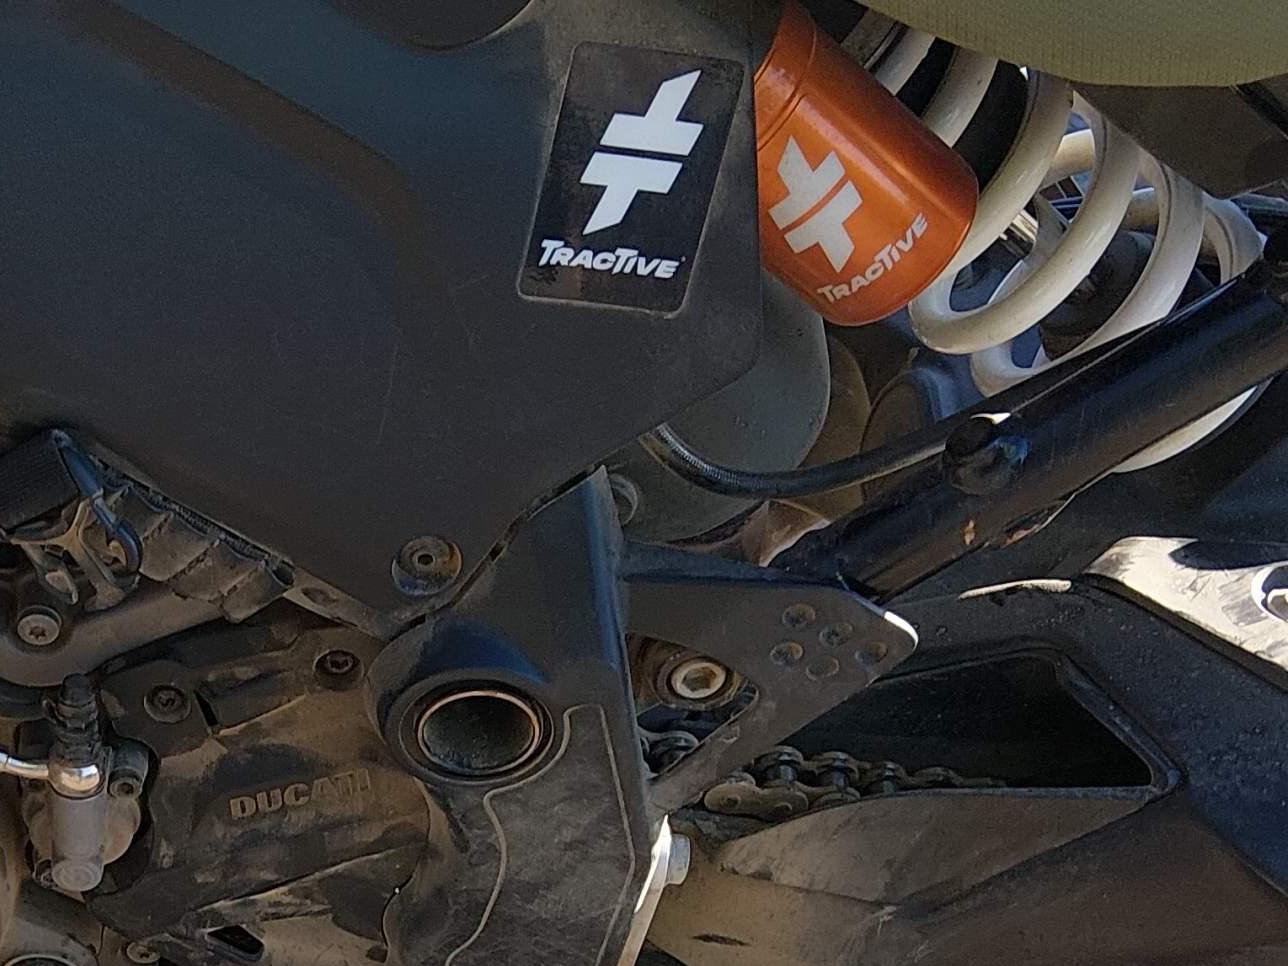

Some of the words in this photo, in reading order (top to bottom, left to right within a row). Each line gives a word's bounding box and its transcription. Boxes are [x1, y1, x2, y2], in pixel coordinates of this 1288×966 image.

[538, 239, 680, 279] TRACTIVE
[816, 212, 929, 303] TRACTIVE
[230, 767, 371, 820] DUCATI
